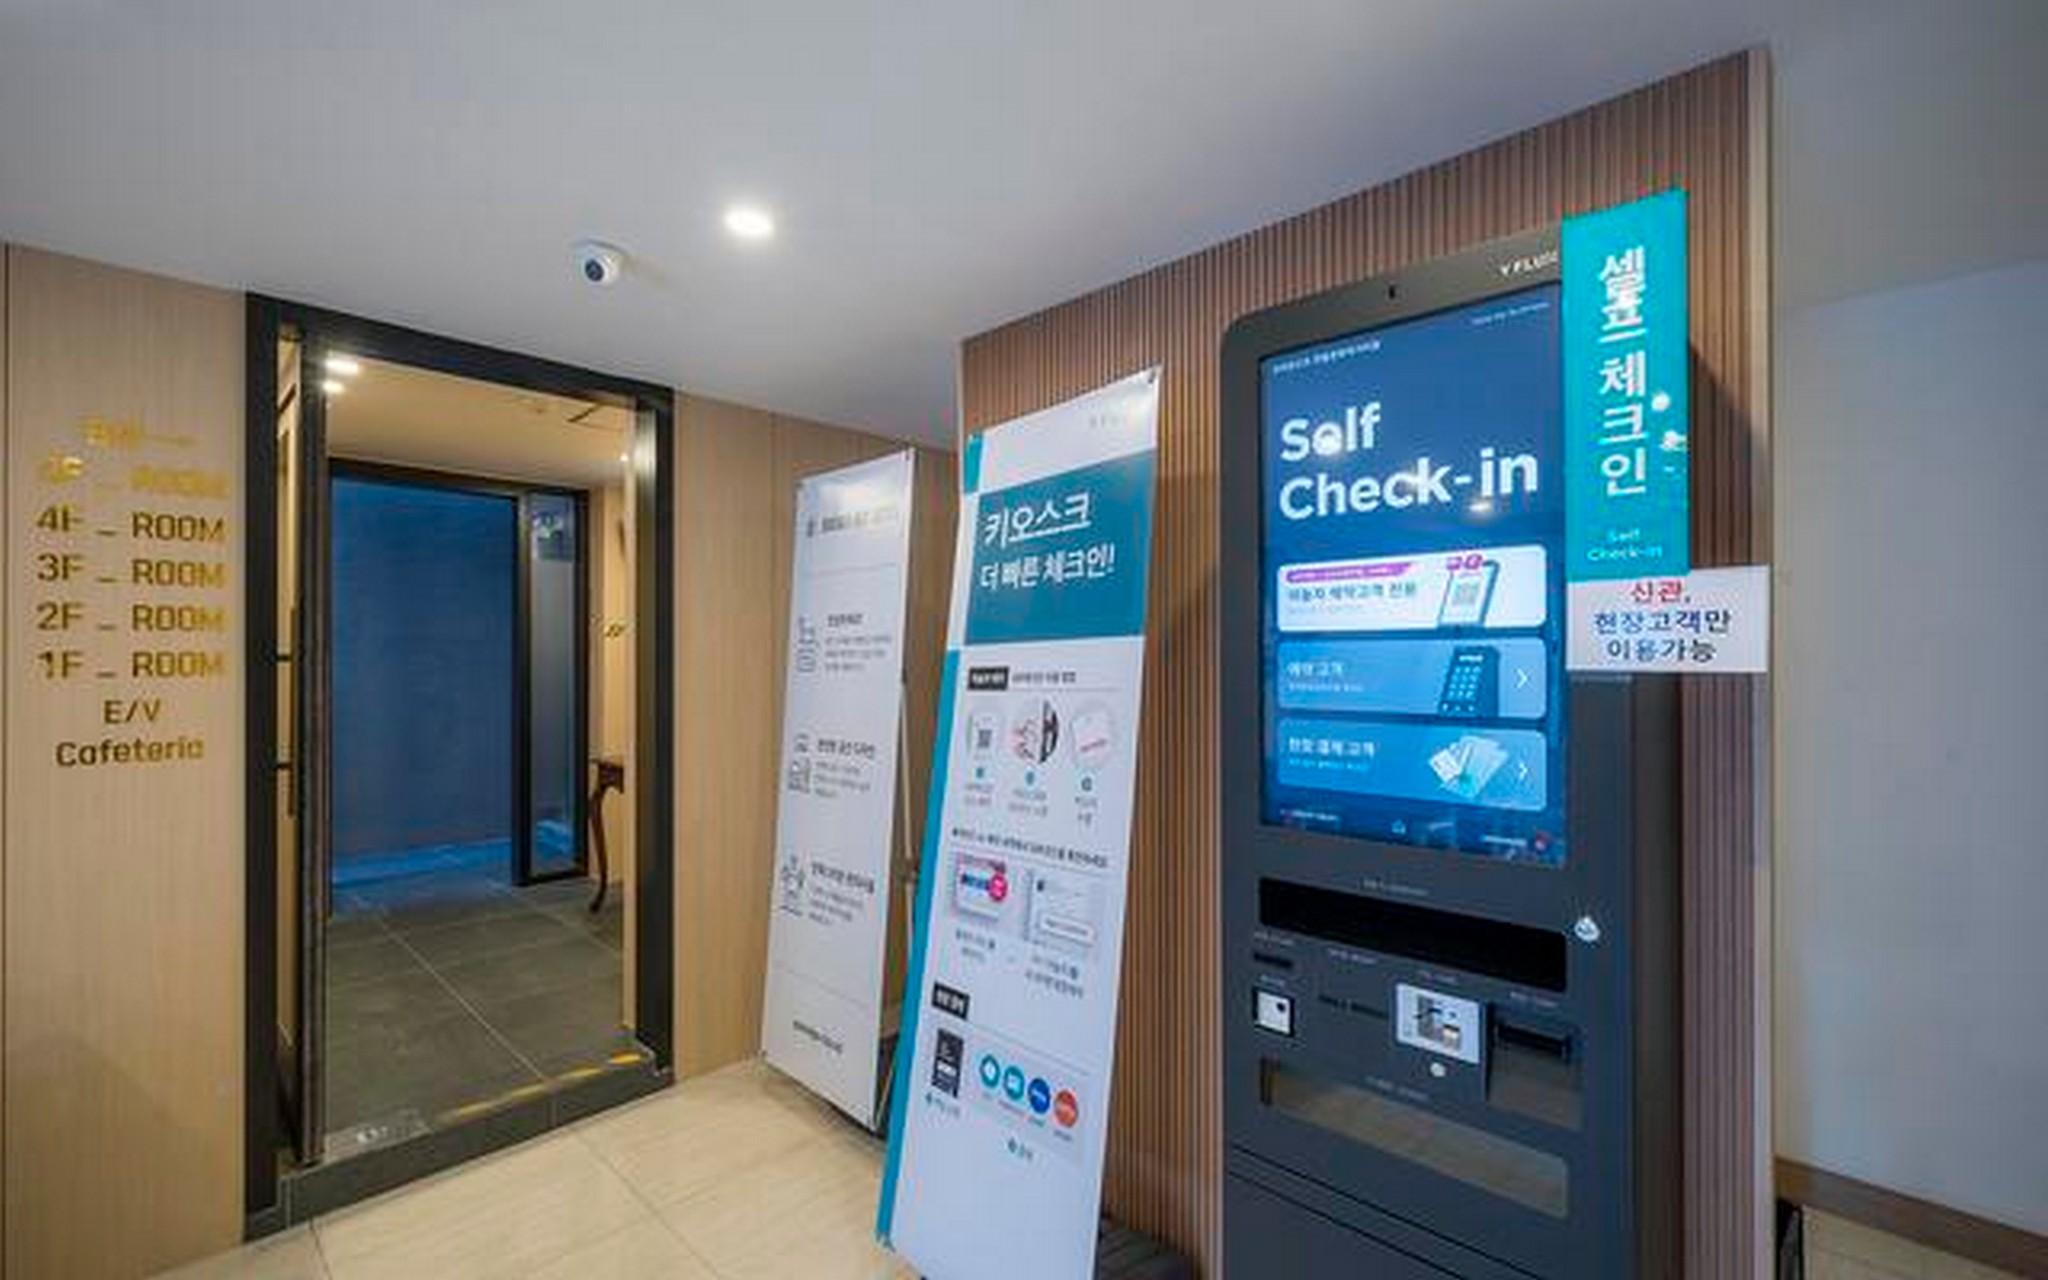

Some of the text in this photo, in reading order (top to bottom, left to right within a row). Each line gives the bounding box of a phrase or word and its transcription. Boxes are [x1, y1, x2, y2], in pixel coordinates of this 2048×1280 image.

[1280, 402, 1382, 461] Self
[1279, 447, 1540, 520] Check-in
[36, 506, 84, 533] 4F
[131, 511, 226, 541] ROOM
[984, 492, 1092, 549] 키오스크
[36, 554, 84, 582] 3F
[131, 559, 226, 588] ROOM
[980, 560, 998, 591] 더
[36, 602, 83, 631] 2F
[131, 604, 226, 633] ROOM
[1594, 610, 1731, 635] 현장고객만
[37, 651, 84, 679] 1F
[131, 651, 226, 679] ROOM
[1607, 639, 1717, 663] 이용가능
[104, 700, 162, 725] E/V
[55, 736, 205, 768] Cafeteria
